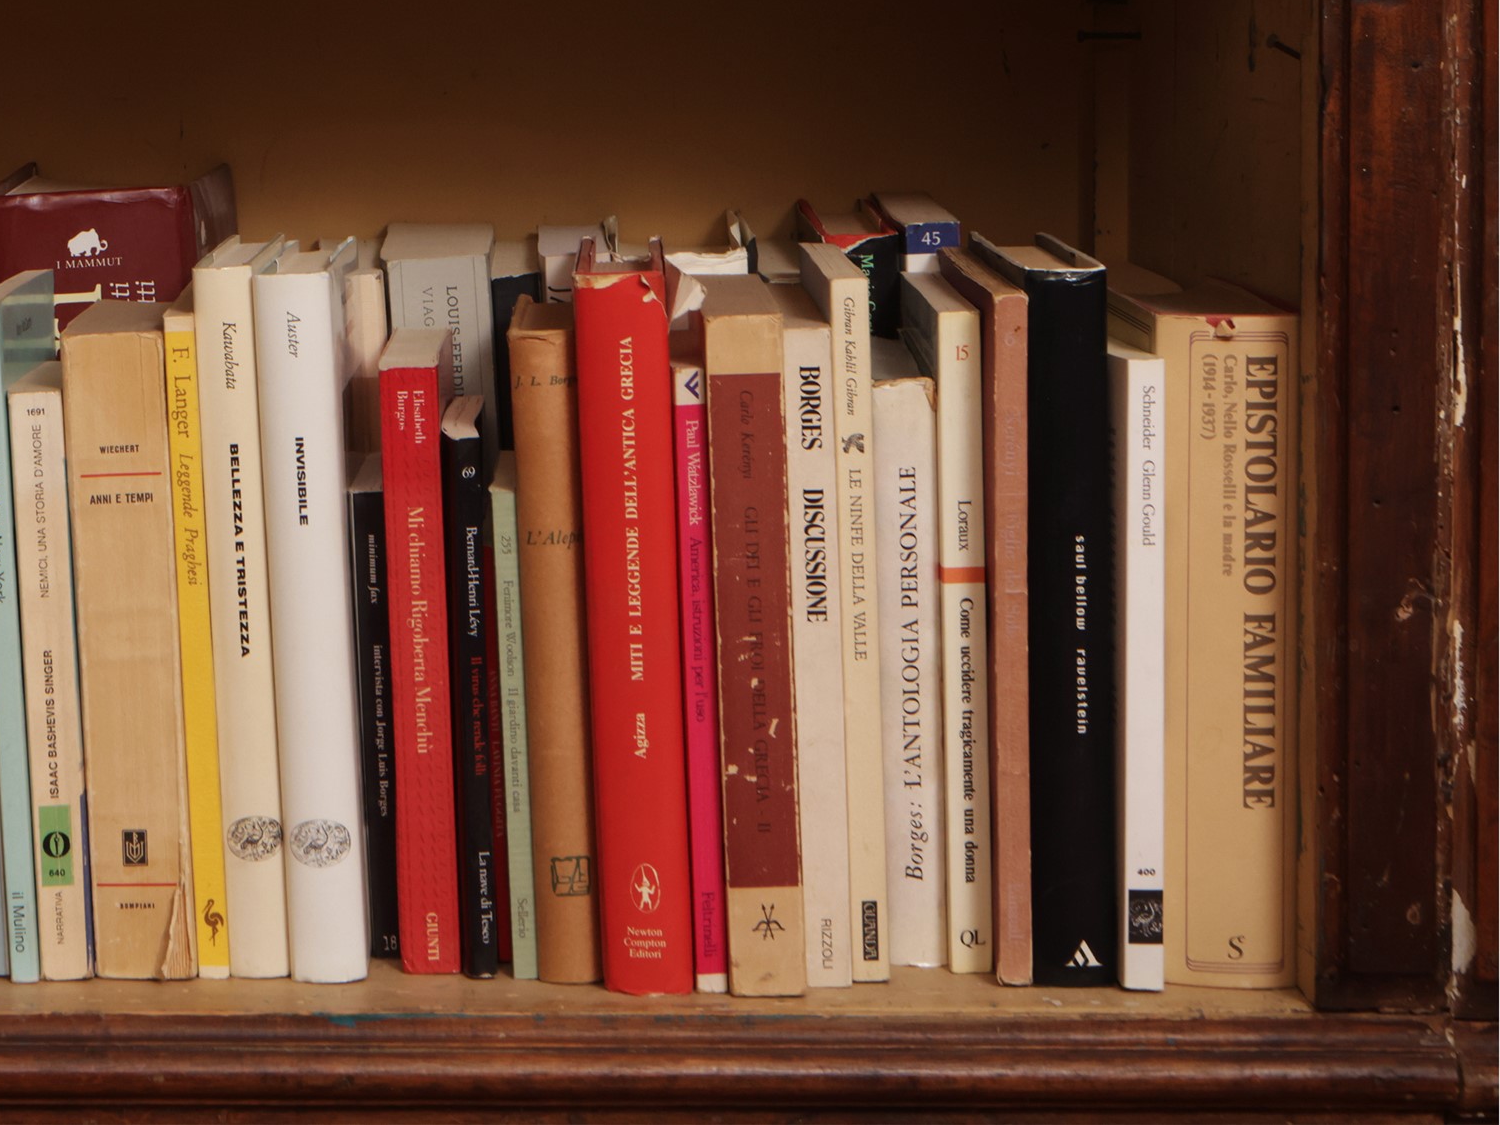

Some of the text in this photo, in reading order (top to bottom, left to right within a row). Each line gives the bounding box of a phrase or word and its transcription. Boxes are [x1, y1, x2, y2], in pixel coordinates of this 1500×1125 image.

[66, 257, 122, 269] MAMMUT
[921, 229, 941, 246] 45
[222, 322, 239, 389] Kawabata
[286, 311, 300, 358] Auster
[956, 346, 969, 361] 15
[172, 347, 191, 438] F. Langer
[620, 337, 633, 400] GRECIA
[1222, 354, 1237, 398] Carlo,
[799, 366, 822, 450] BORGES
[1143, 386, 1156, 450] Schneider
[1223, 402, 1237, 438] Nello
[99, 445, 139, 453] WIECHERT
[1223, 444, 1237, 499] Rosselli
[89, 493, 153, 505] ANNI E TEMPI
[295, 437, 308, 525] INVISIBILE
[1142, 460, 1155, 545] Glenn Gould
[229, 444, 250, 657] BELLEZZA E TRISTEZZA
[899, 467, 918, 608] PERSONALE
[958, 501, 972, 551] Loraux
[1223, 516, 1236, 527] la
[626, 527, 642, 617] LEGGENDE
[803, 489, 828, 623] DISCUSSIONE
[1075, 535, 1088, 631] saul bellow
[1223, 533, 1236, 576] madre
[1243, 354, 1278, 810] EPISTOLARIO FAMILIARE
[630, 625, 642, 635] E
[630, 644, 643, 680] MITI
[1076, 649, 1089, 734] ravelstein
